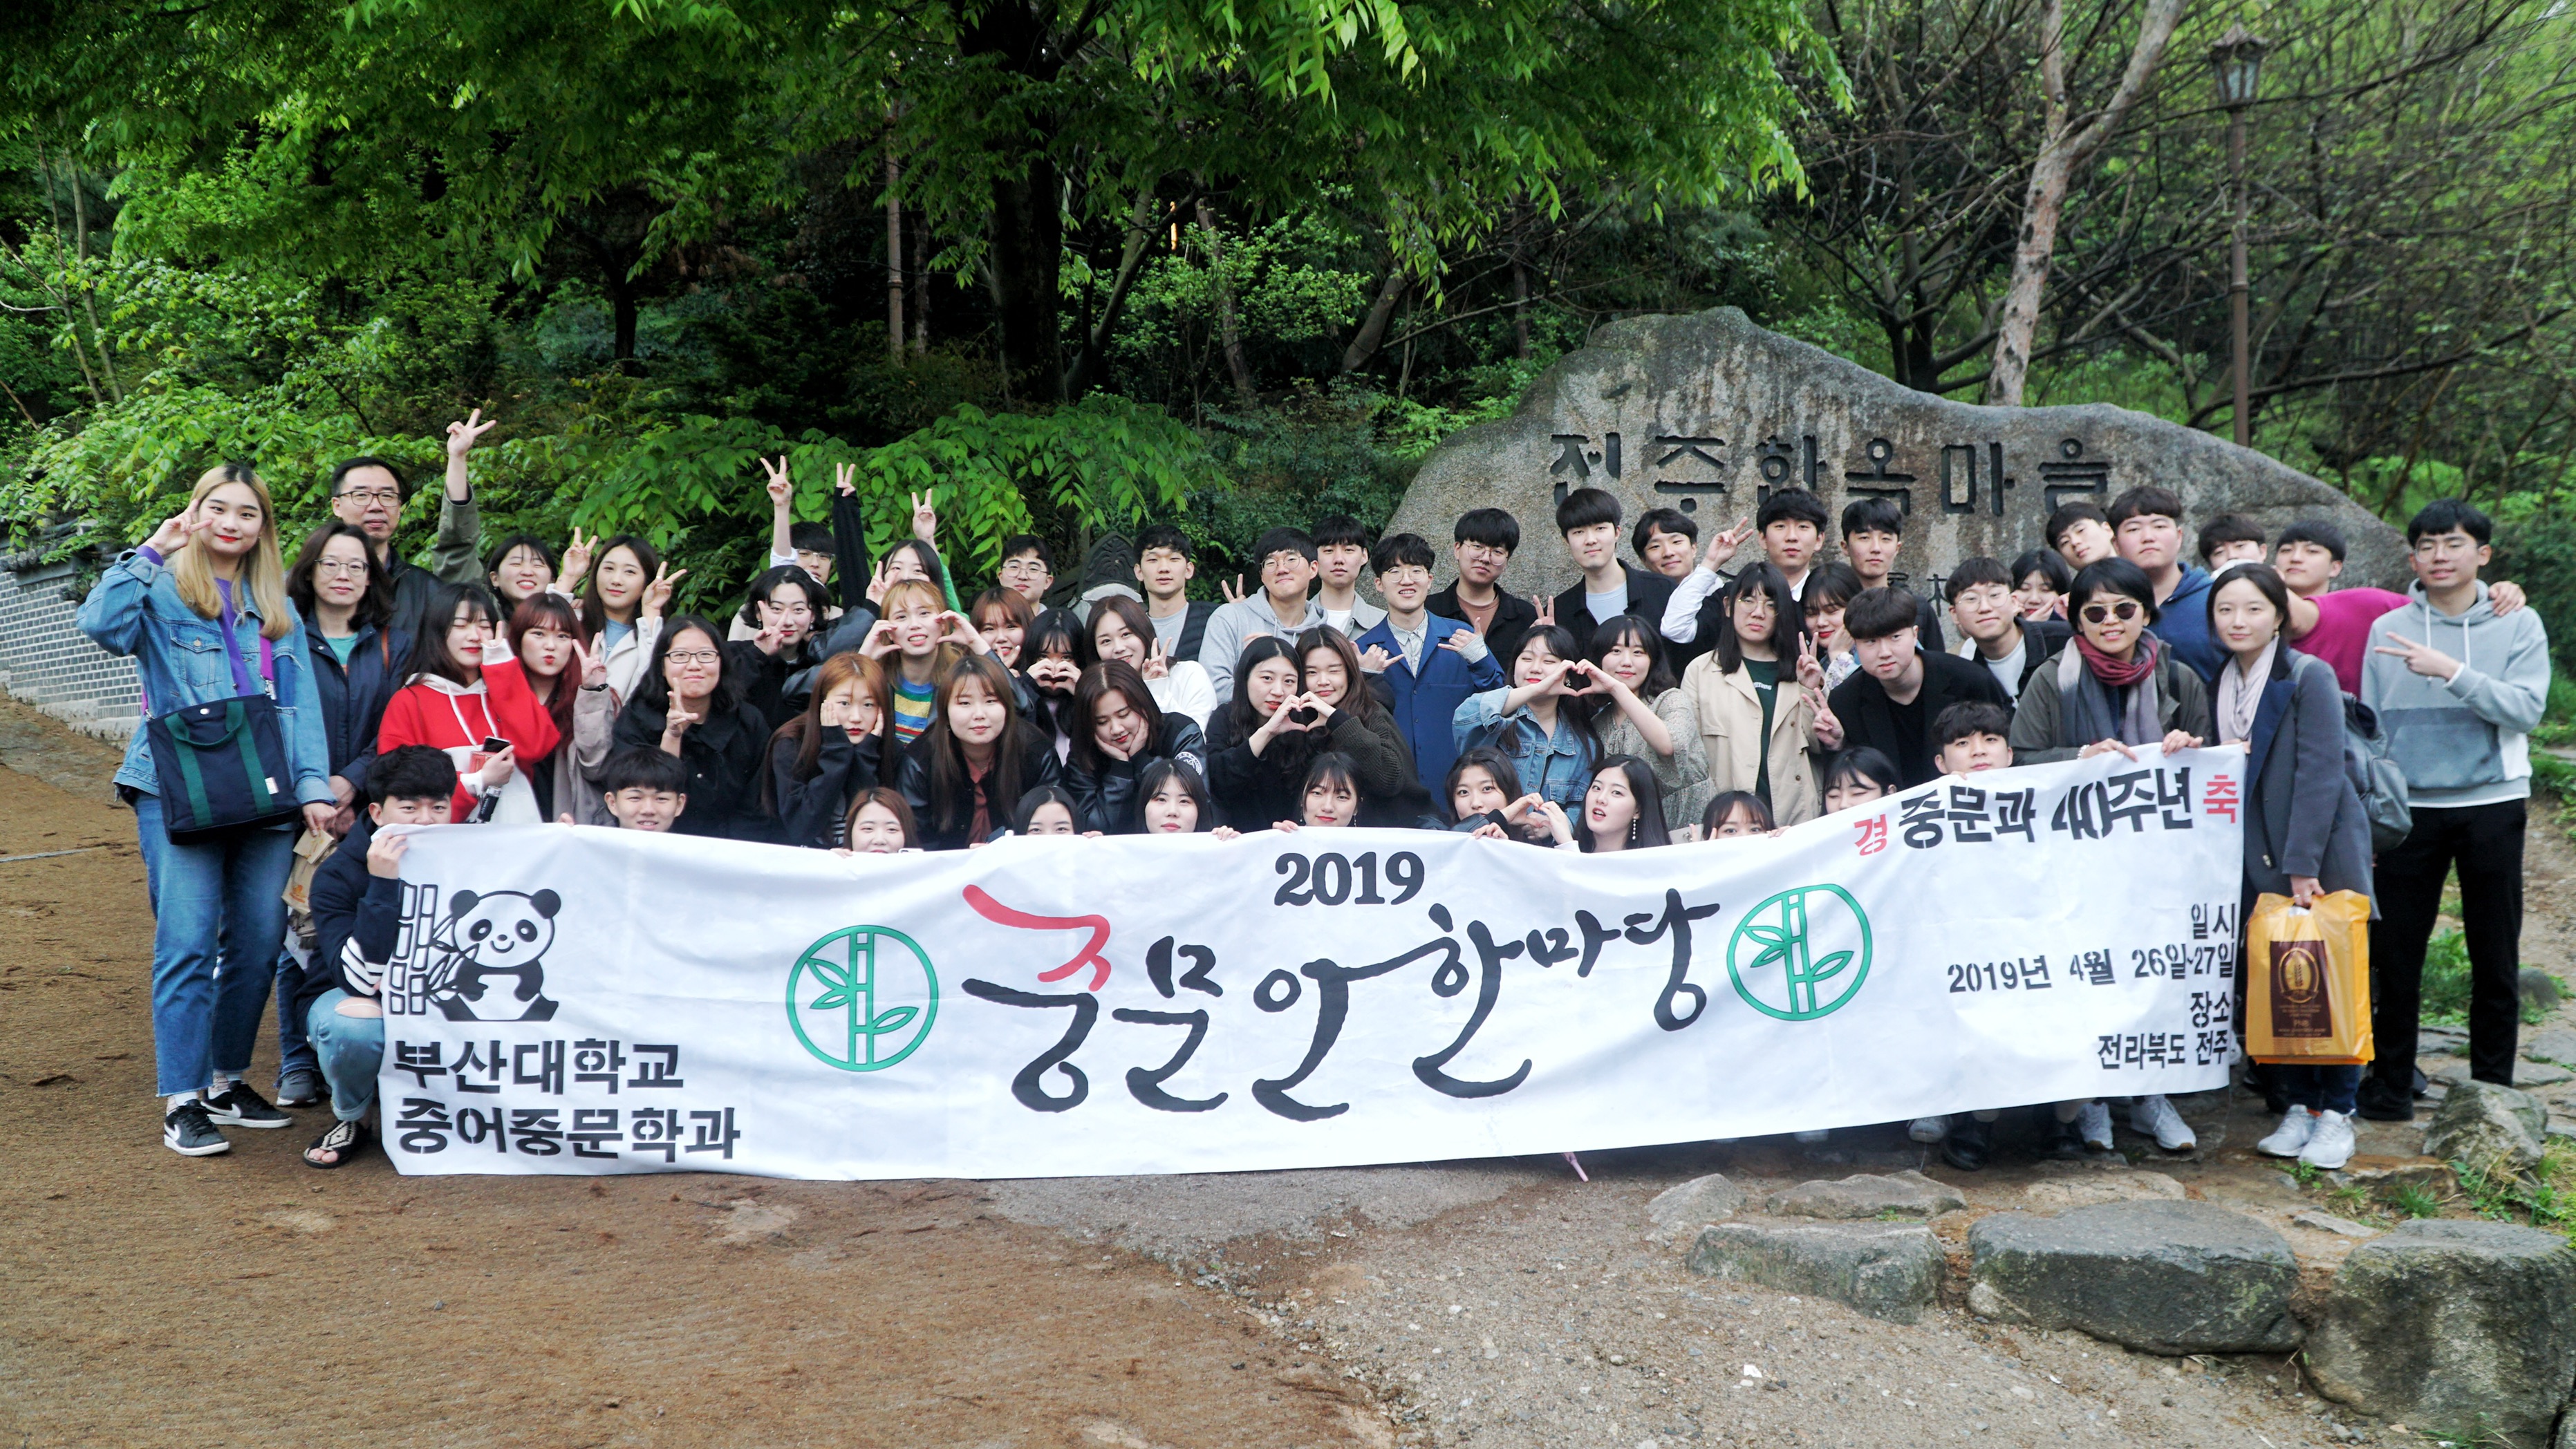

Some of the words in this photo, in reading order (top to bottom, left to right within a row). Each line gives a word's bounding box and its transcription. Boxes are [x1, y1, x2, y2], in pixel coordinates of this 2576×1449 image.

[1854, 814, 1888, 856] 경
[1898, 785, 2037, 849] 중문과
[2051, 767, 2193, 840] 40주년
[2203, 774, 2239, 823] 축
[1273, 851, 1424, 906] 2019
[2191, 903, 2236, 939] 일시
[1948, 955, 2052, 993] 2019년
[2069, 948, 2116, 985] 4월
[2190, 991, 2230, 1028] 장소
[393, 1038, 684, 1095] 부산대학교
[2098, 1032, 2186, 1070] 전라북도
[2196, 1029, 2228, 1066] 전주
[395, 1098, 740, 1163] 중어중문학과
